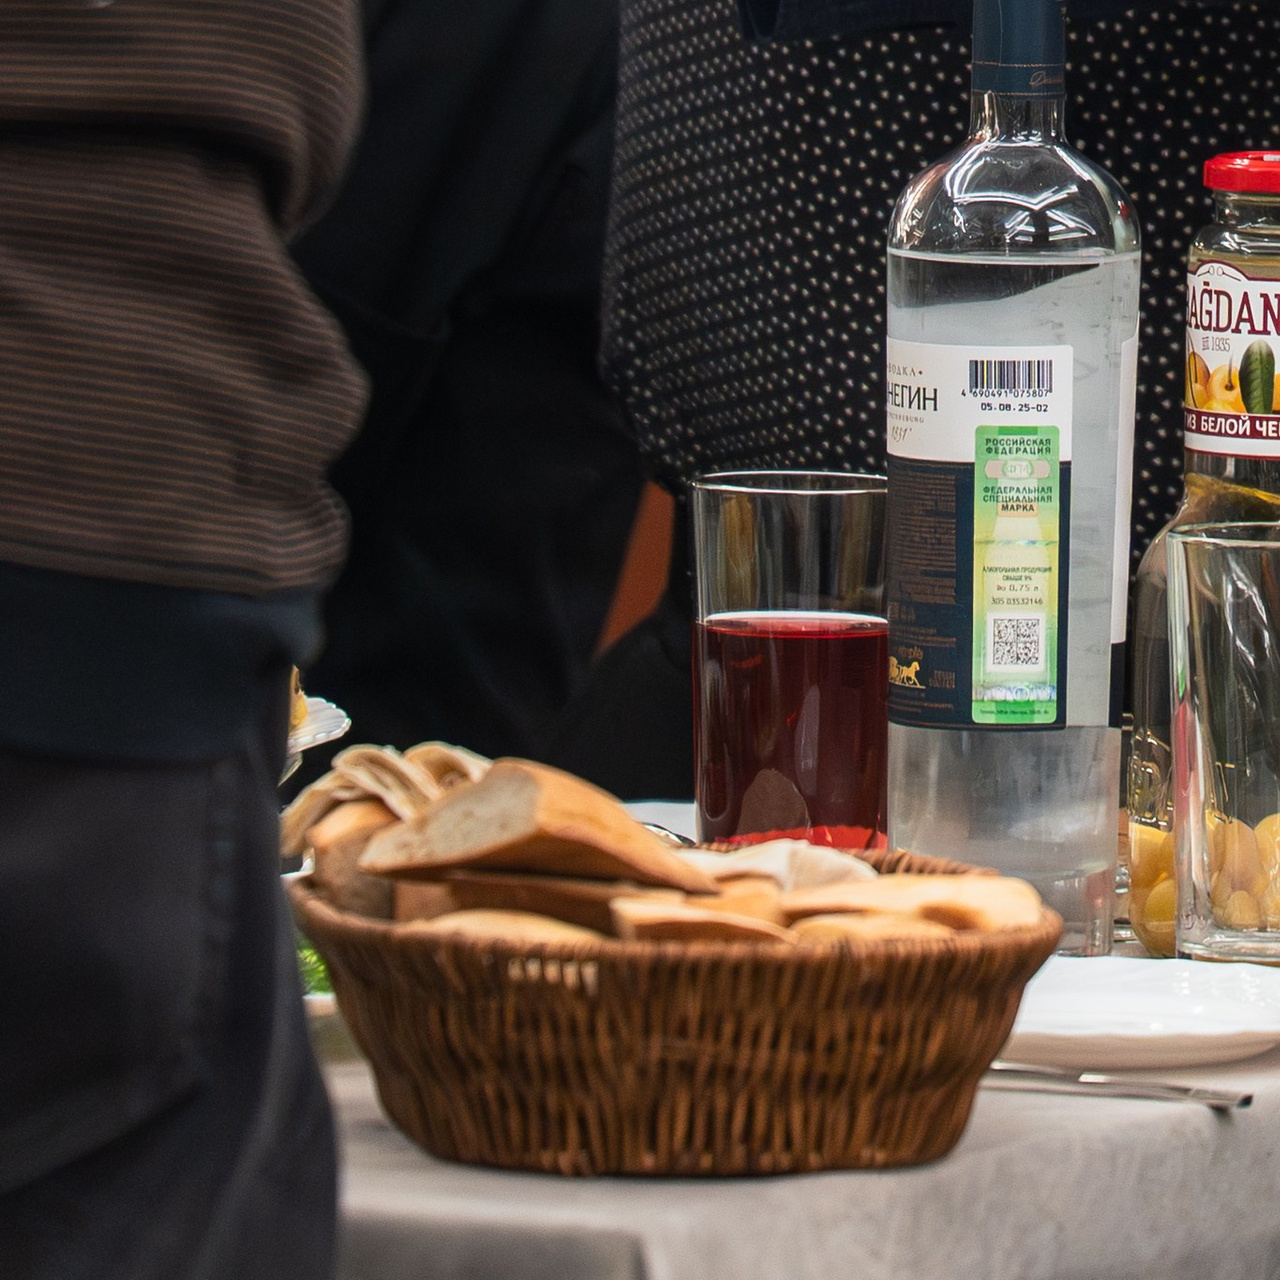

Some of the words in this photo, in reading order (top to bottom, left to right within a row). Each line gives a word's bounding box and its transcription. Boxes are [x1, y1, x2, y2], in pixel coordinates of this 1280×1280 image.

[1211, 336, 1231, 352] 1935
[960, 389, 966, 398] 4
[980, 402, 1049, 413] 05.08.25-02
[1200, 415, 1251, 436] БЕЛОЙ
[985, 437, 1052, 447] РОССИЙСКАЯ
[985, 446, 1052, 455] ФЕДЕРАЦИЯ
[982, 485, 1053, 495] ФЕДЕРАЛЬНАЯ
[982, 494, 1053, 504] СПЕЦИАЛЬНАЯ
[1001, 504, 1036, 513] МАРКА
